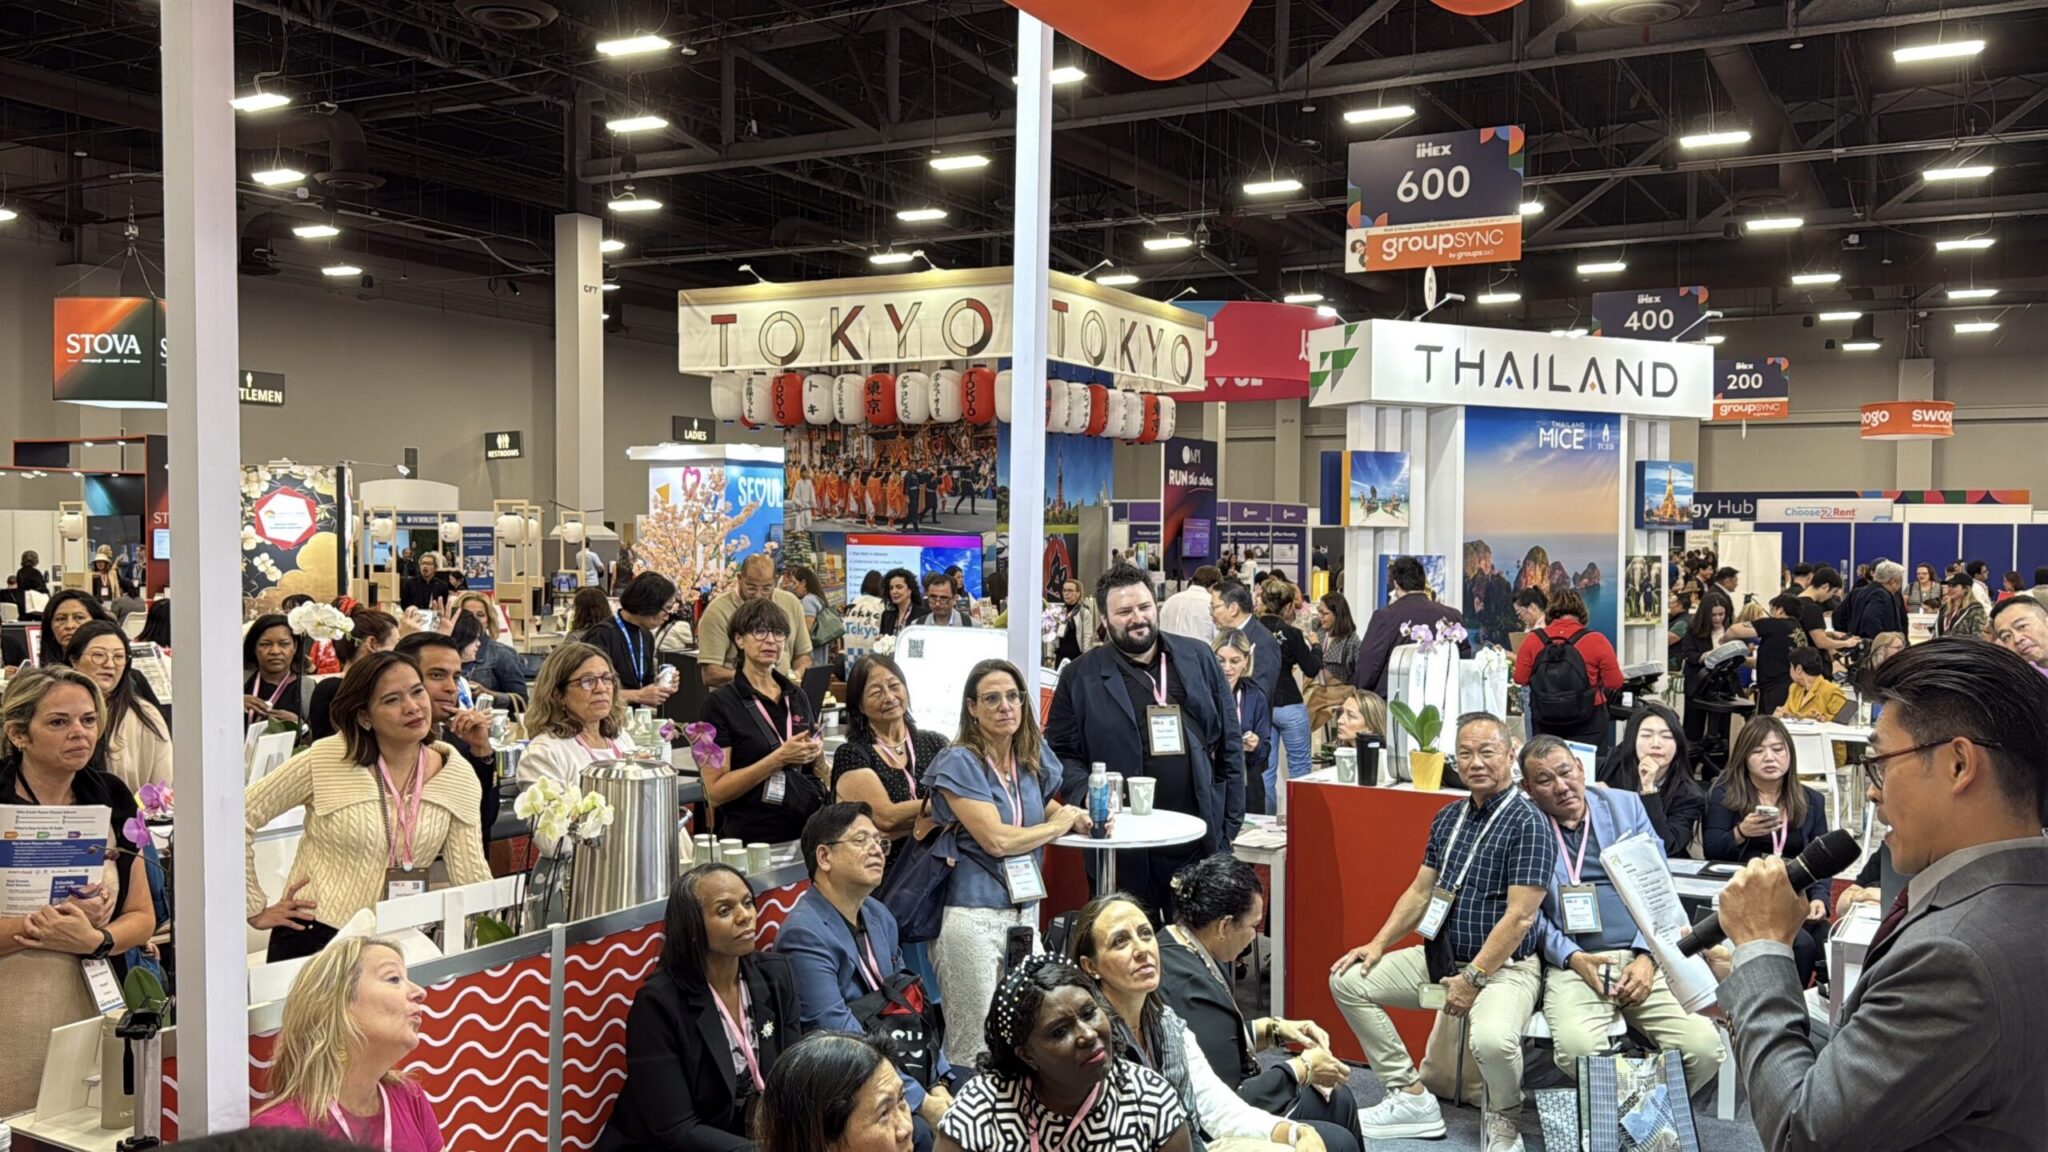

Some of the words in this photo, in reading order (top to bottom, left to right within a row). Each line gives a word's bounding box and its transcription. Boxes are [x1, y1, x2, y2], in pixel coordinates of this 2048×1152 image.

[1396, 165, 1470, 203] 600
[1381, 228, 1504, 261] groupSYNC
[584, 284, 598, 295] CF7
[1624, 308, 1674, 331] 400
[66, 333, 142, 354] STOVA
[711, 298, 994, 368] TOKYO
[1051, 299, 1193, 386] TOKYO
[1414, 344, 1678, 398] THAILAND
[1726, 373, 1763, 390] 200
[775, 376, 785, 419] TOKYO
[867, 380, 882, 415] 東京
[965, 371, 976, 417] TOKYO
[1719, 403, 1780, 416] groupSYNC
[684, 430, 707, 441] LADIES
[1551, 421, 1586, 429] THAILAND
[1539, 427, 1585, 450] MICE
[487, 450, 520, 458] RESTROOMS
[1169, 469, 1188, 486] RUN
[1718, 499, 1754, 514] Hub
[845, 622, 878, 639] Tokyo
